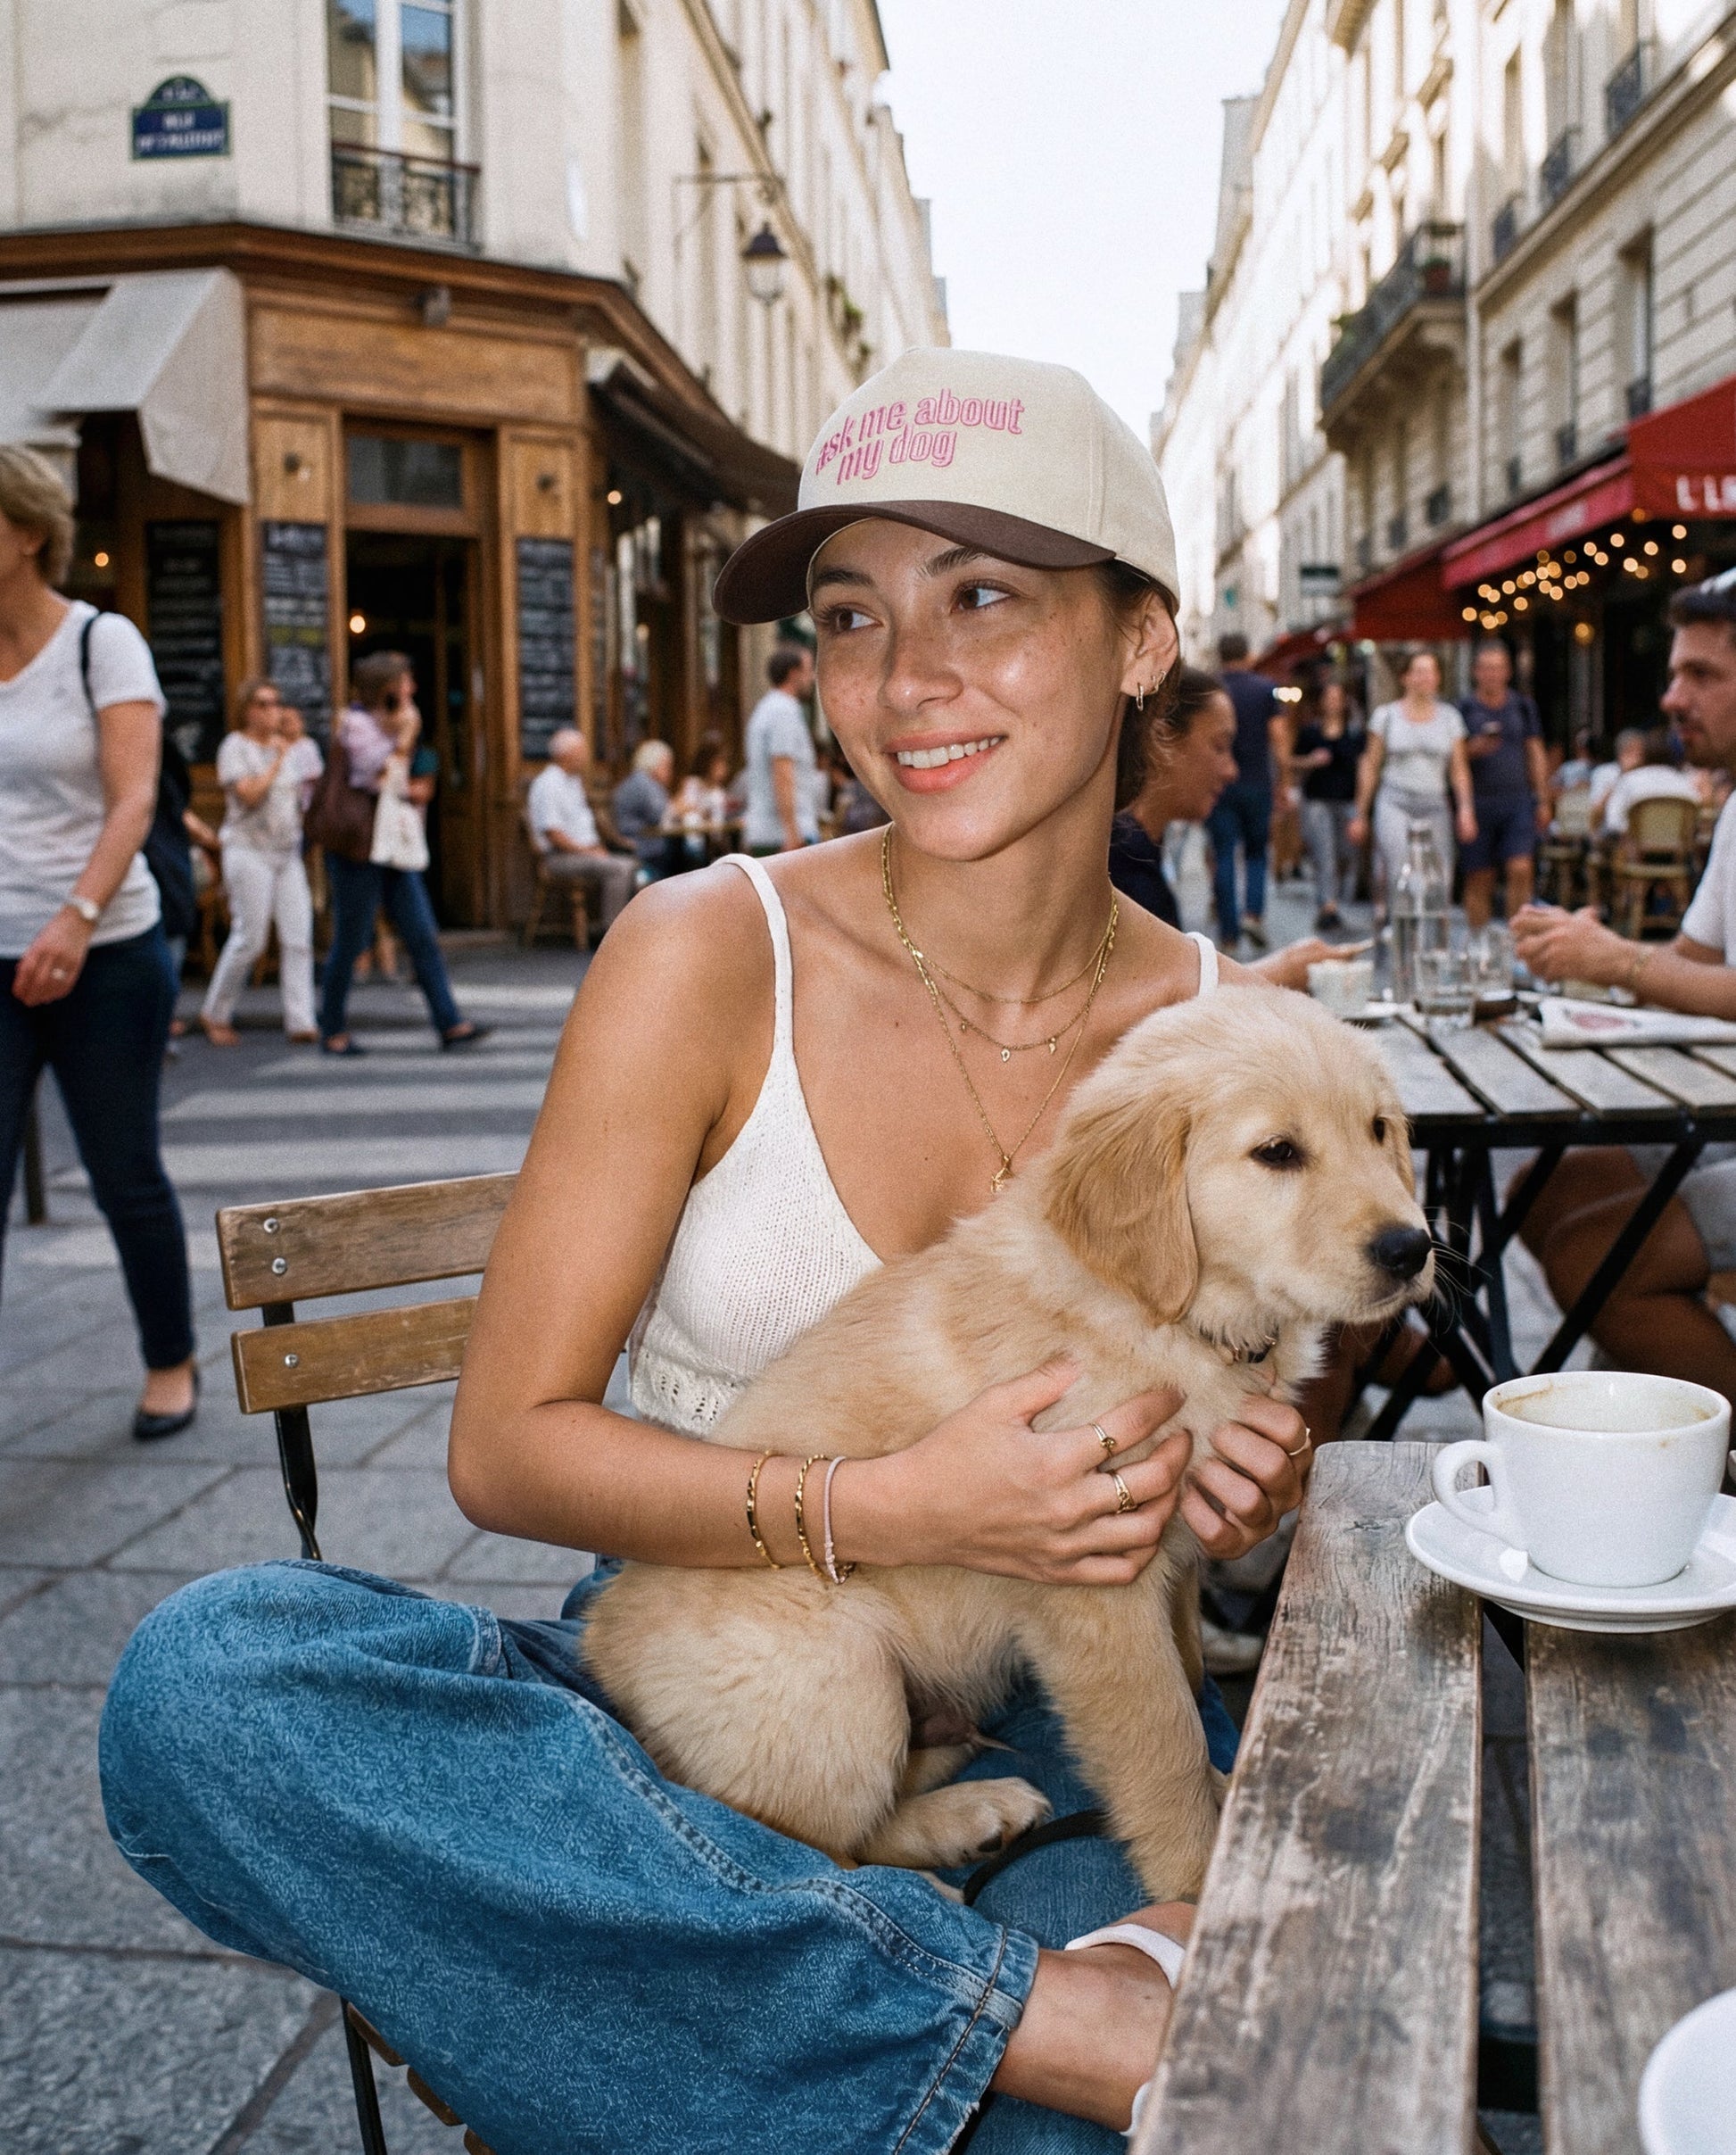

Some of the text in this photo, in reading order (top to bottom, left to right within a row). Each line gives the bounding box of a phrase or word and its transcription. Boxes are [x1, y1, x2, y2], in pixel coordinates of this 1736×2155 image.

[815, 388, 1026, 475] ask me about
[836, 425, 957, 485] my dog
